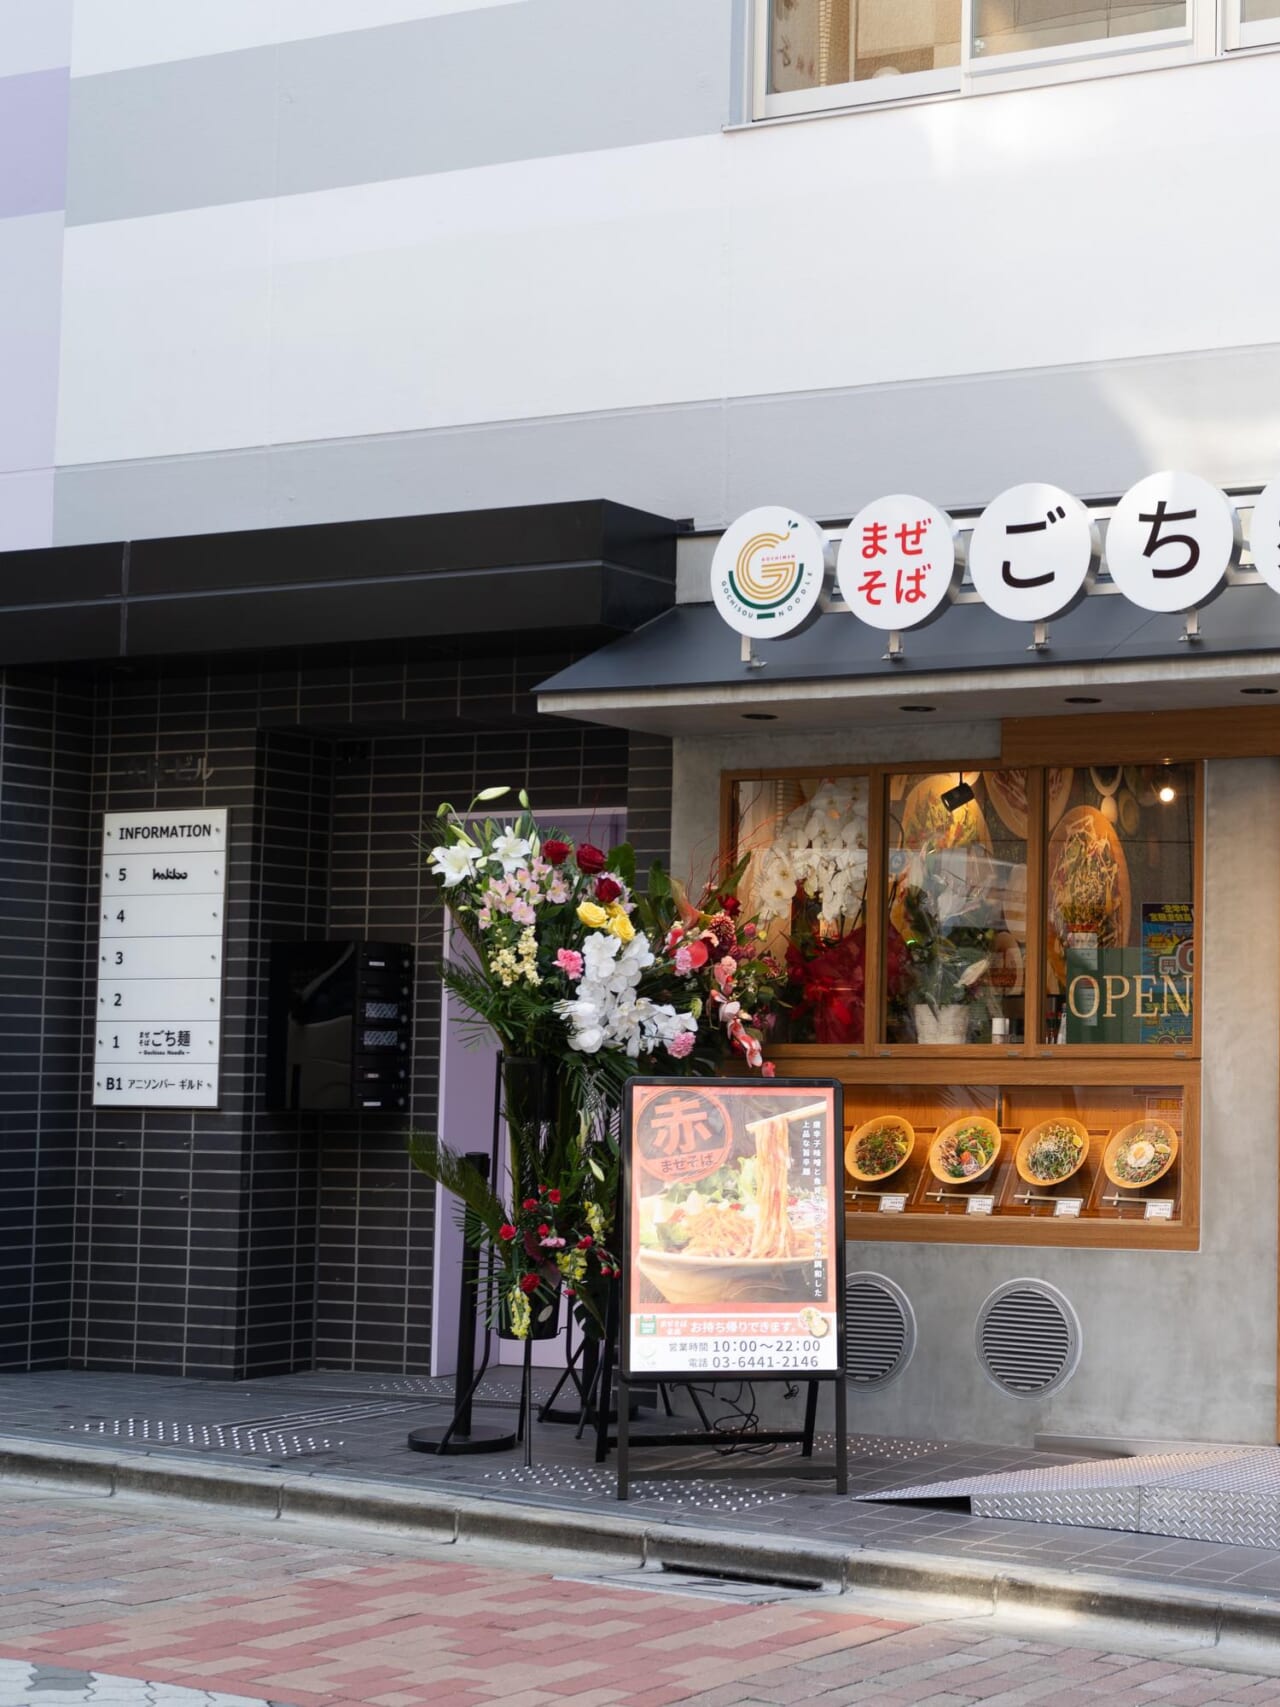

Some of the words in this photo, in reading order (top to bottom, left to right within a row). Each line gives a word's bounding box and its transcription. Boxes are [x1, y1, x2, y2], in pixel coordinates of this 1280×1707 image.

[861, 517, 932, 559] まぜ
[857, 562, 932, 606] そば
[119, 824, 212, 840] INFORMATION
[118, 868, 127, 882] 5
[116, 910, 125, 924] 4
[115, 952, 124, 965] 3
[113, 994, 122, 1007] 2
[1068, 974, 1193, 1018] OPEN
[112, 1036, 120, 1049] 1
[151, 1029, 191, 1047] ごち麺
[106, 1078, 123, 1091] B1
[128, 1079, 176, 1090] アニソンバー
[179, 1078, 204, 1090] ギルド
[651, 1096, 712, 1154] 赤
[668, 1343, 709, 1353] 営業時間
[688, 1358, 709, 1368] 電話
[712, 1356, 819, 1369] 03-6441-2146
